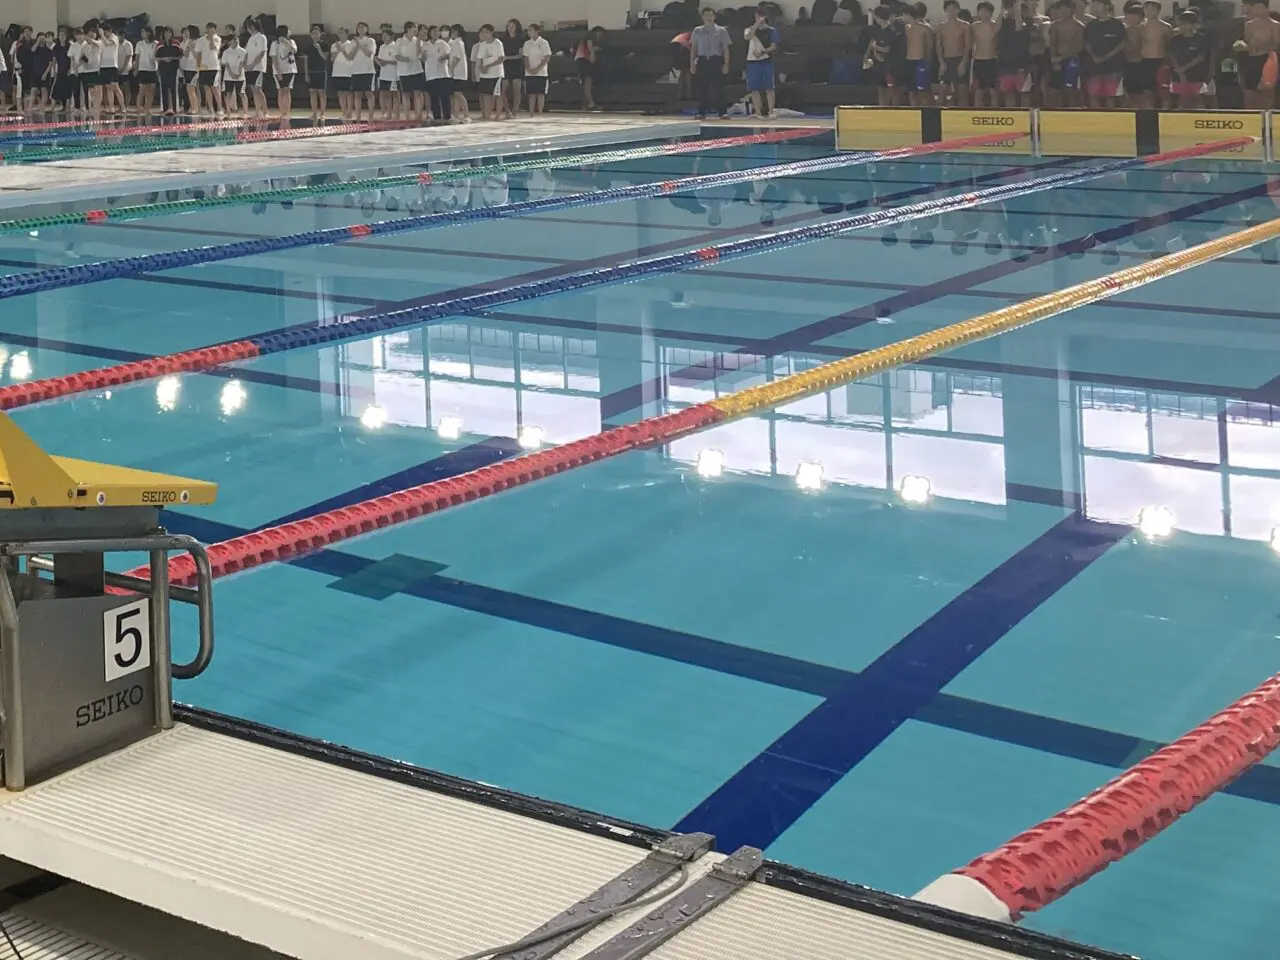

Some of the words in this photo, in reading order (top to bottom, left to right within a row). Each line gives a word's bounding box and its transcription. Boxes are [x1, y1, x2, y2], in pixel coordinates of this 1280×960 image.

[972, 116, 1015, 126] SEIKO
[1194, 119, 1244, 130] SEIKO
[141, 490, 177, 503] SEIKO
[114, 607, 142, 668] 5
[75, 684, 144, 728] SEIKO
